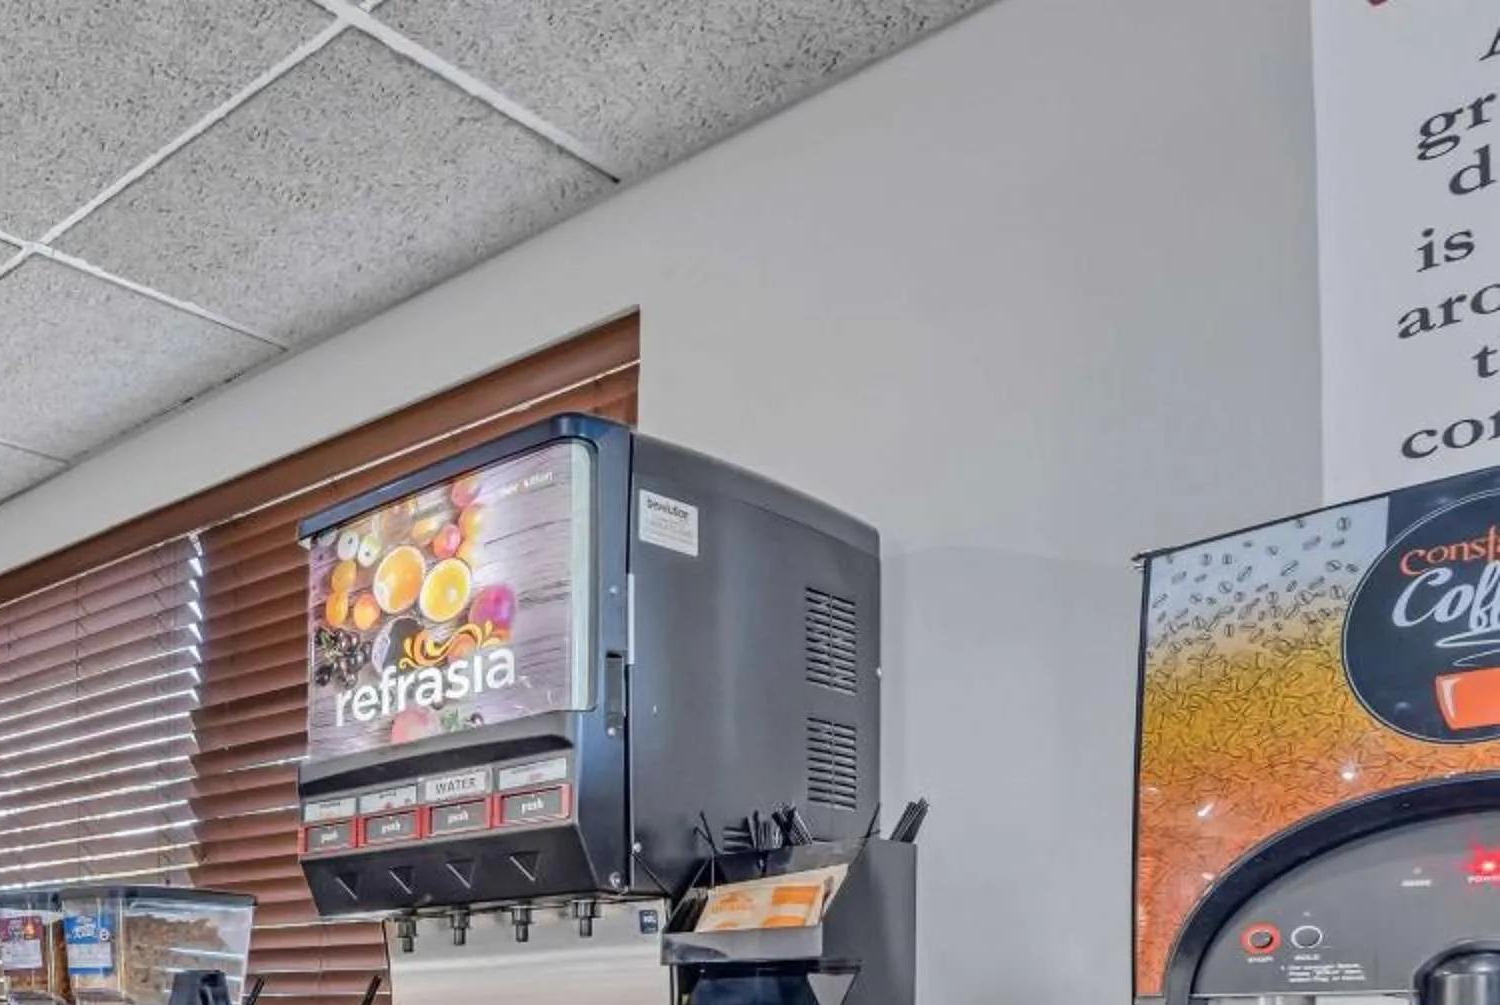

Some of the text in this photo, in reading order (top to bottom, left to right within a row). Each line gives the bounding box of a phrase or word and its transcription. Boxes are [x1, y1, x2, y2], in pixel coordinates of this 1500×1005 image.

[1416, 228, 1475, 272] is
[1401, 525, 1500, 576] Const
[435, 776, 478, 795] WATER
